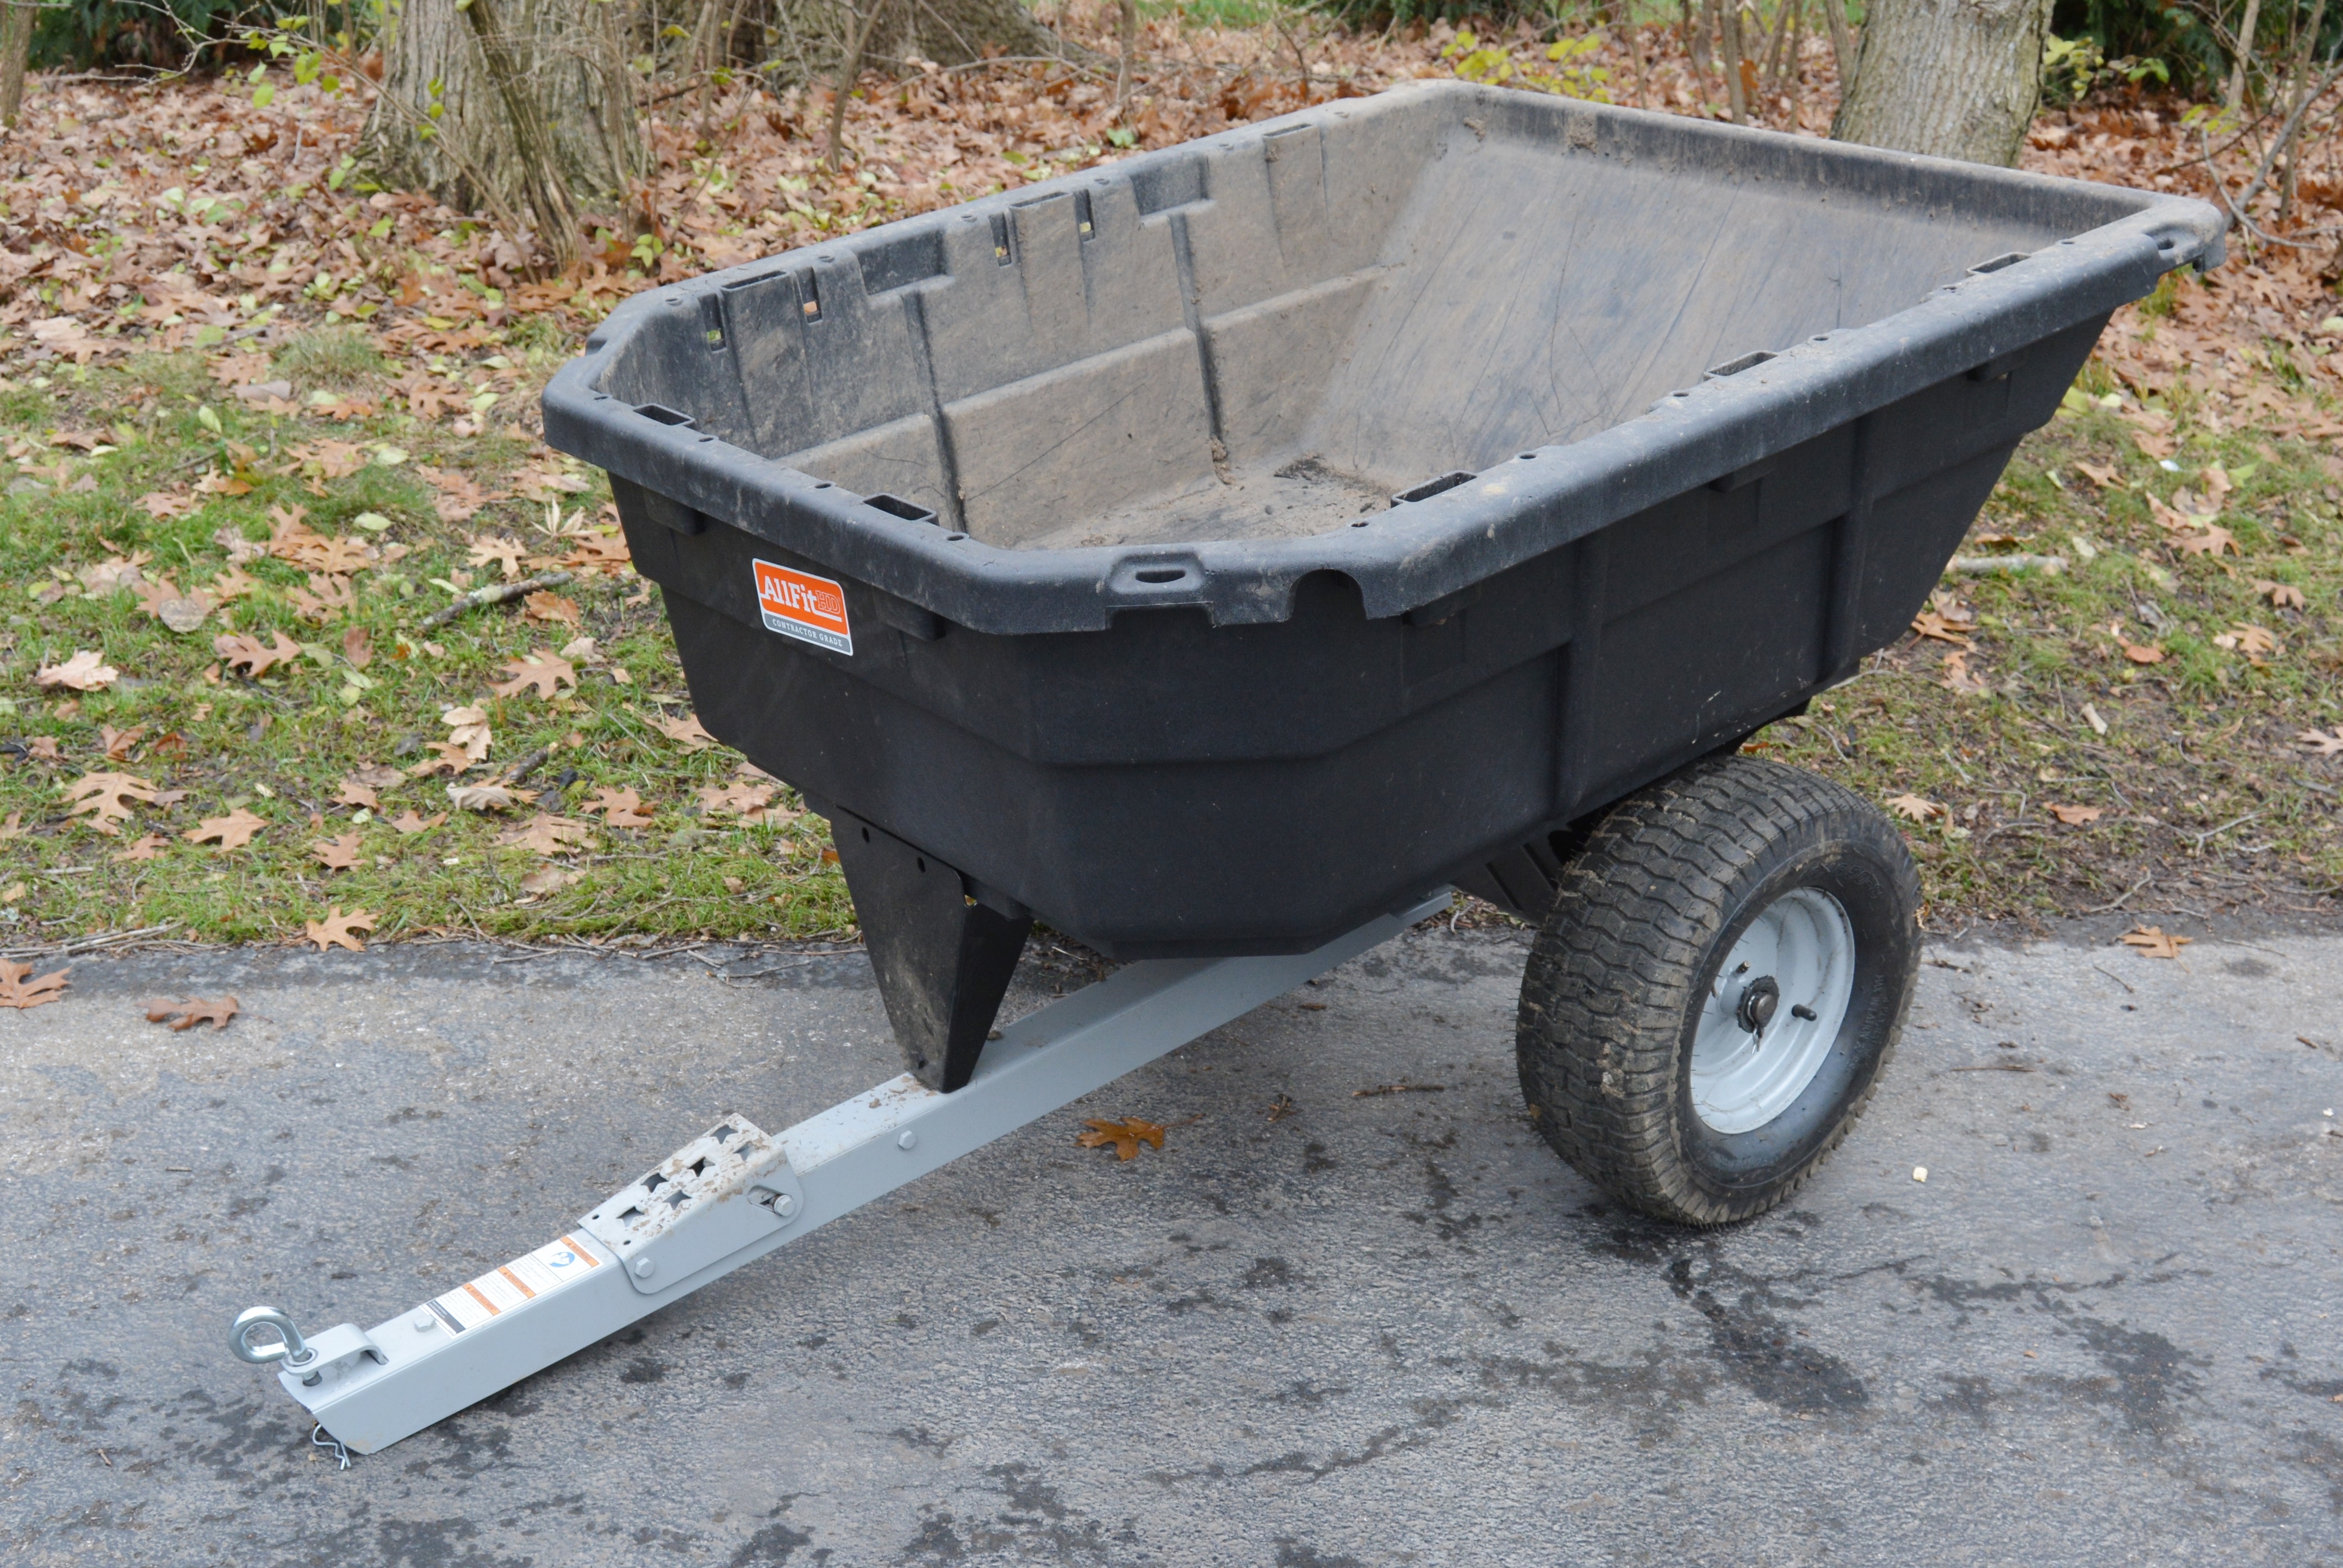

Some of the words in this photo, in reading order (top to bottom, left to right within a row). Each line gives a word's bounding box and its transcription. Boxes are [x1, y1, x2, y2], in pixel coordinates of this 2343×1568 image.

[772, 619, 817, 639] CONTRACTOR
[819, 633, 843, 647] GRADE
[1873, 975, 1885, 992] MAX
[1860, 997, 1880, 1039] INFLATION
